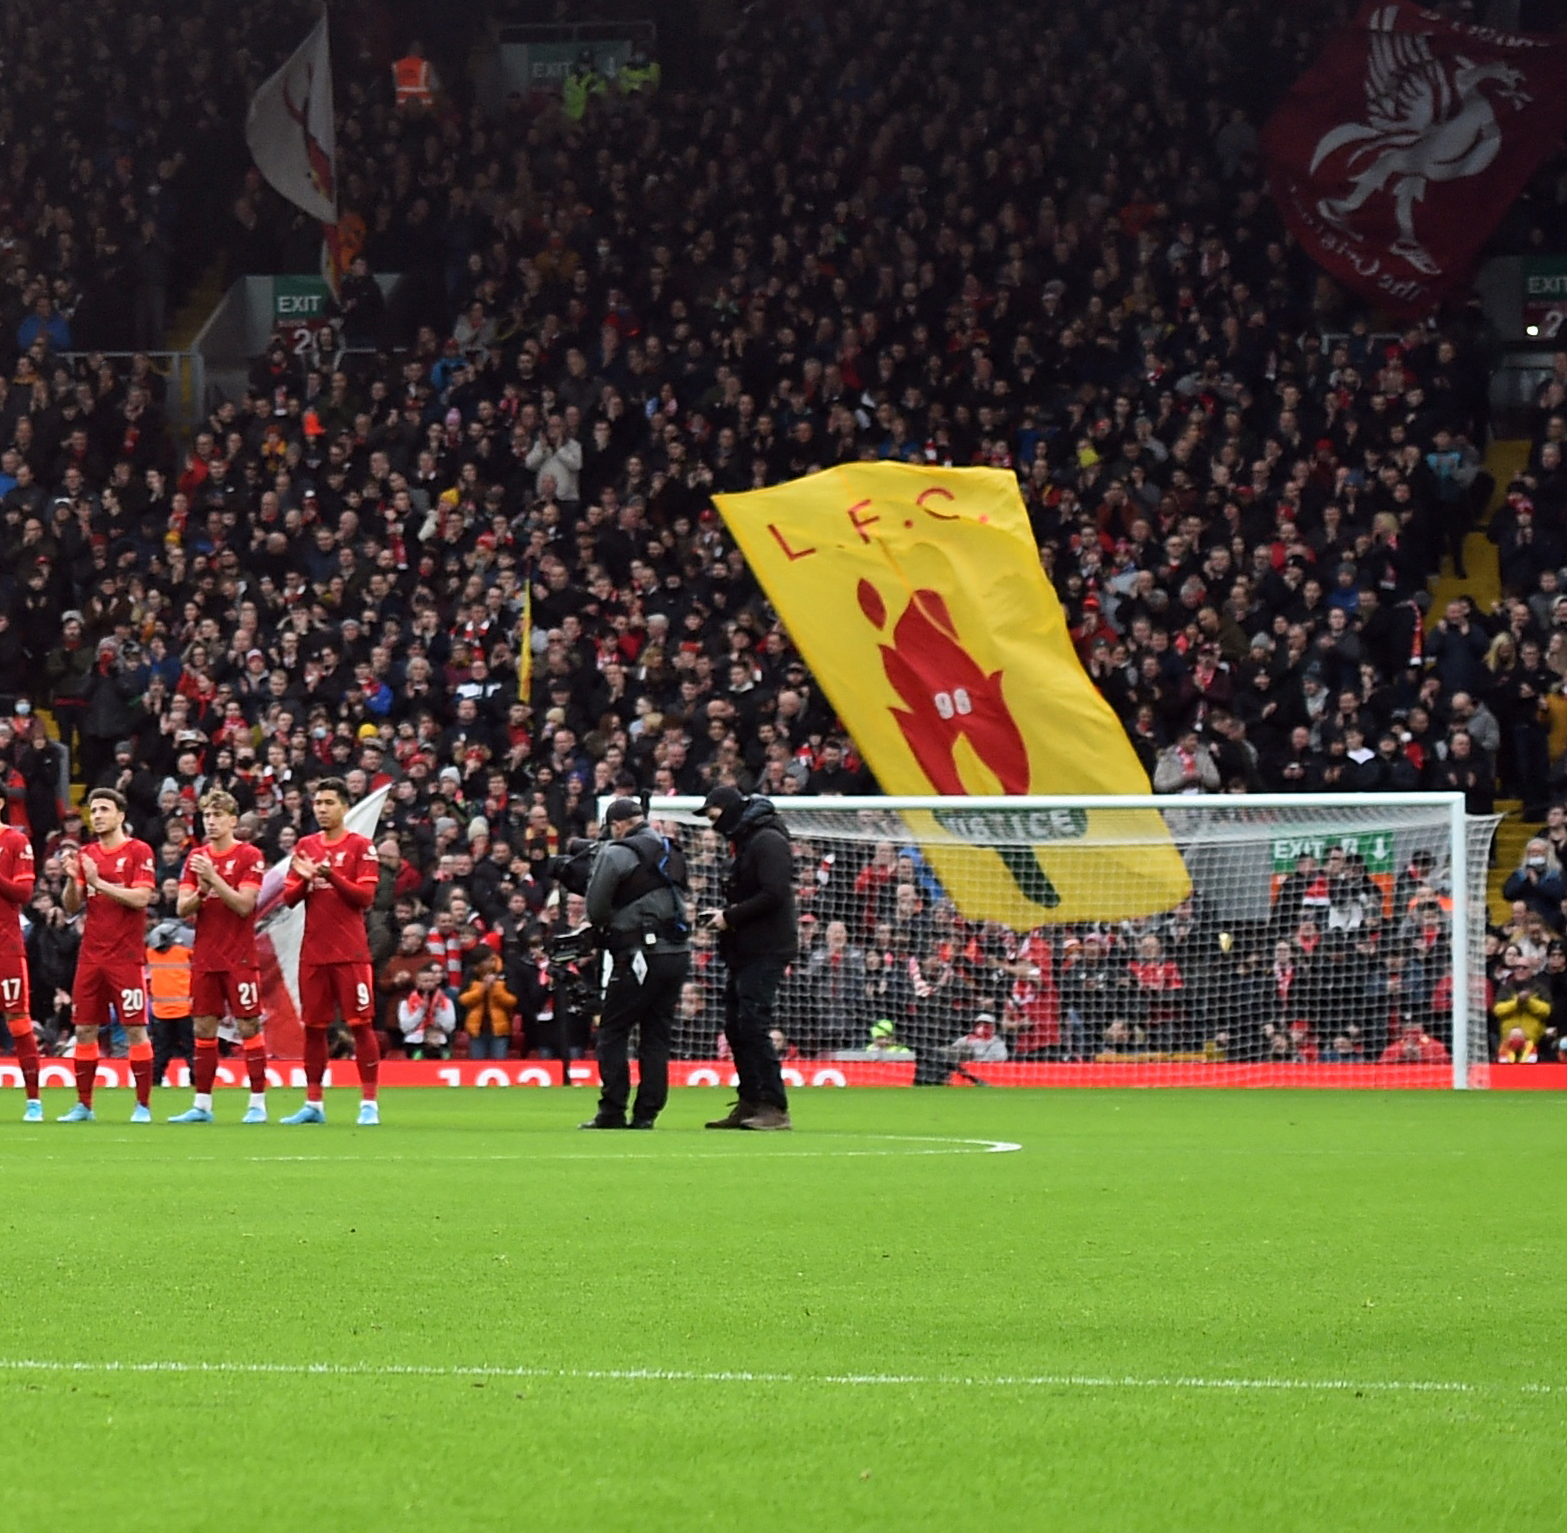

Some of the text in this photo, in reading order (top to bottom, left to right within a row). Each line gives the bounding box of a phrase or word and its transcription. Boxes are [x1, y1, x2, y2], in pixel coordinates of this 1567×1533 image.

[277, 295, 322, 313] EXIT
[1274, 839, 1326, 860] EXIT
[1, 978, 22, 1001] 17
[121, 988, 144, 1010] 20
[237, 982, 258, 1005] 21
[356, 983, 370, 1005] 9
